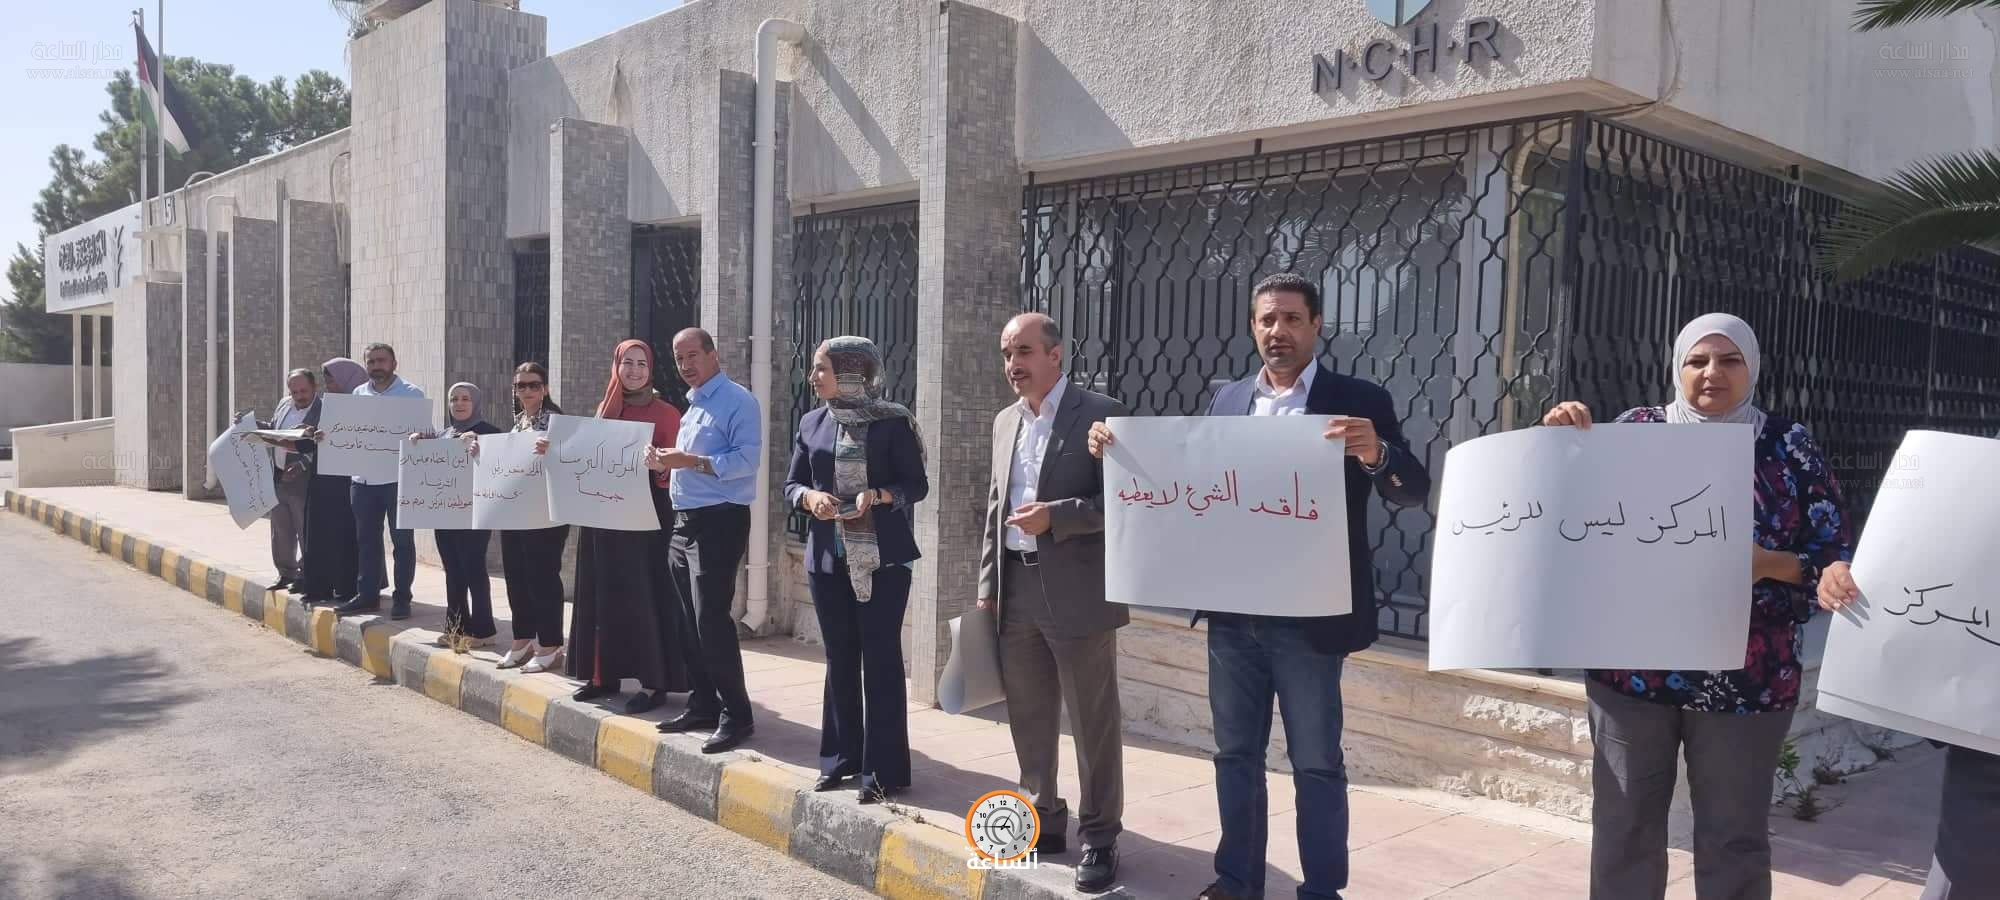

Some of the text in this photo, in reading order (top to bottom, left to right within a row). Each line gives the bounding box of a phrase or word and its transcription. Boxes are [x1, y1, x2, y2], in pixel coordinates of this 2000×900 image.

[1249, 471, 1319, 520] فاقد
[1636, 483, 1727, 544] المركز
[1558, 500, 1625, 541] ليس
[1883, 583, 1989, 626] المركز
